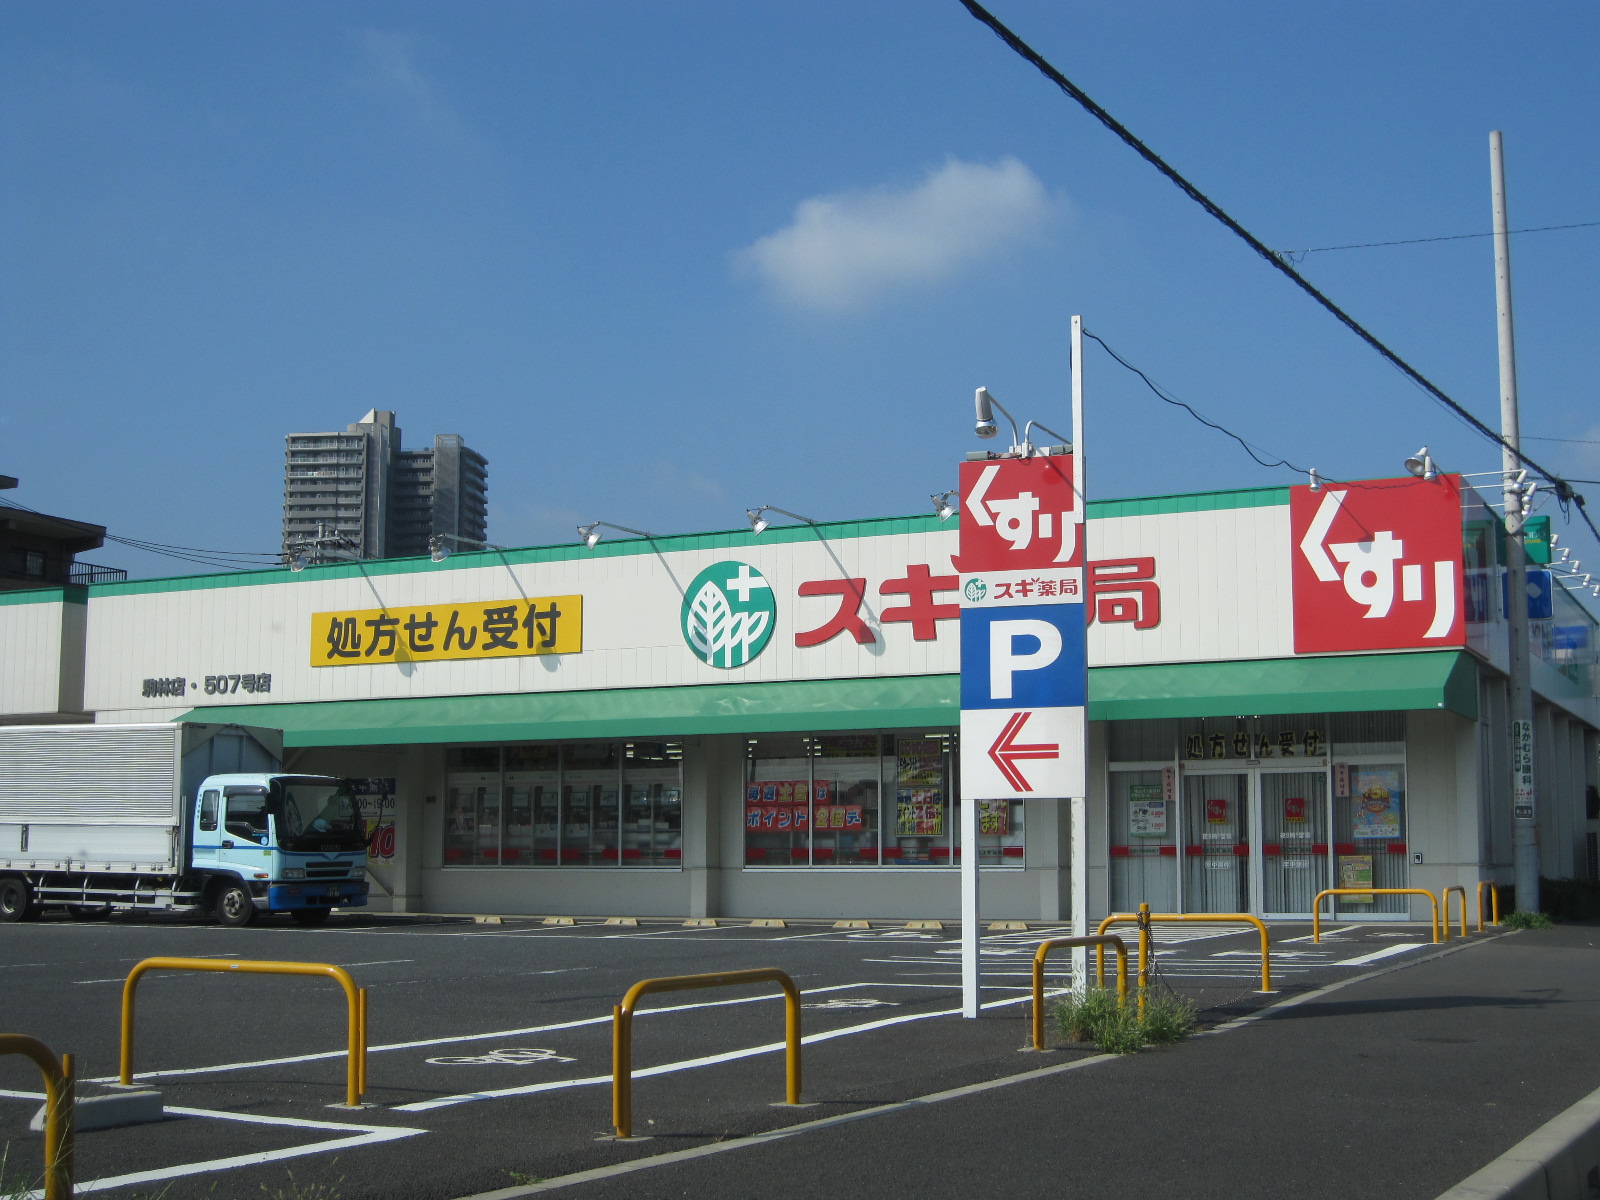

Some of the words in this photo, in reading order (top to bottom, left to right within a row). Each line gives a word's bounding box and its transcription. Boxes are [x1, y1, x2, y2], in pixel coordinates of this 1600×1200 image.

[965, 465, 1077, 563] くすり
[994, 576, 1078, 600] スギ薬局
[1300, 490, 1456, 639] くすり
[326, 602, 562, 660] 処方せん受付
[795, 555, 1161, 648] スギ局
[142, 673, 272, 698] 駒林店・507号店
[989, 619, 1063, 700] P
[1185, 729, 1321, 760] 処方せん受付
[1522, 722, 1532, 786] なかむら眼科
[747, 784, 827, 802] 毎週土日は
